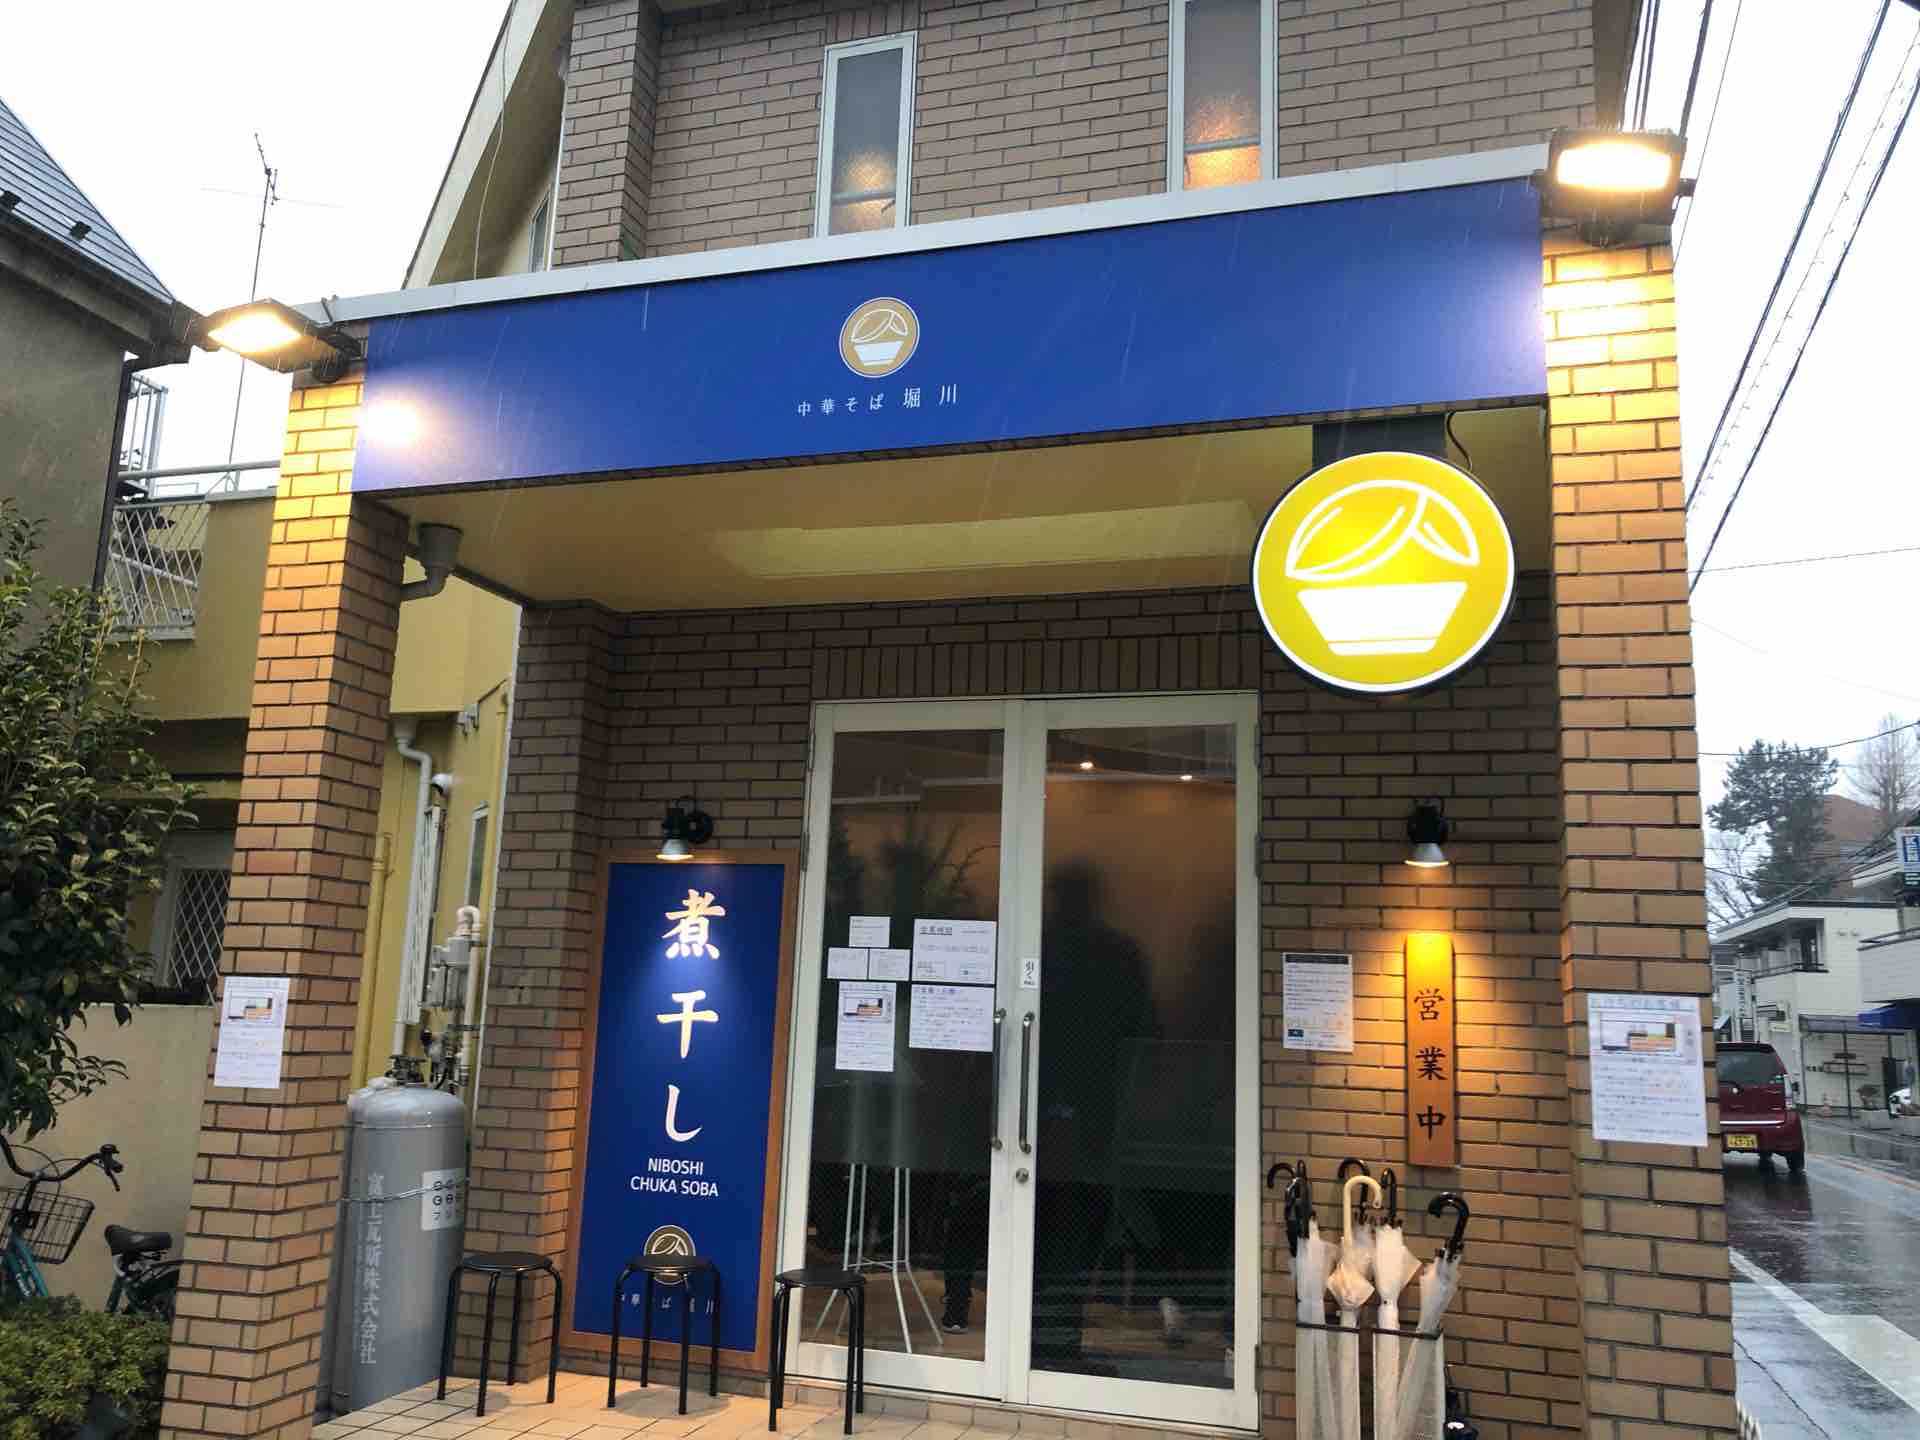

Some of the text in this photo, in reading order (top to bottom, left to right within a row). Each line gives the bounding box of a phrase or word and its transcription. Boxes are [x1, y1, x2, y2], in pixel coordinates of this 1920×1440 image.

[797, 384, 959, 417] 中華そば 堀川
[655, 888, 727, 1143] 煮干し
[1413, 987, 1449, 1141] 営業中
[647, 1157, 704, 1176] NIBOSHI
[629, 1175, 720, 1198] CHUKA SOBA
